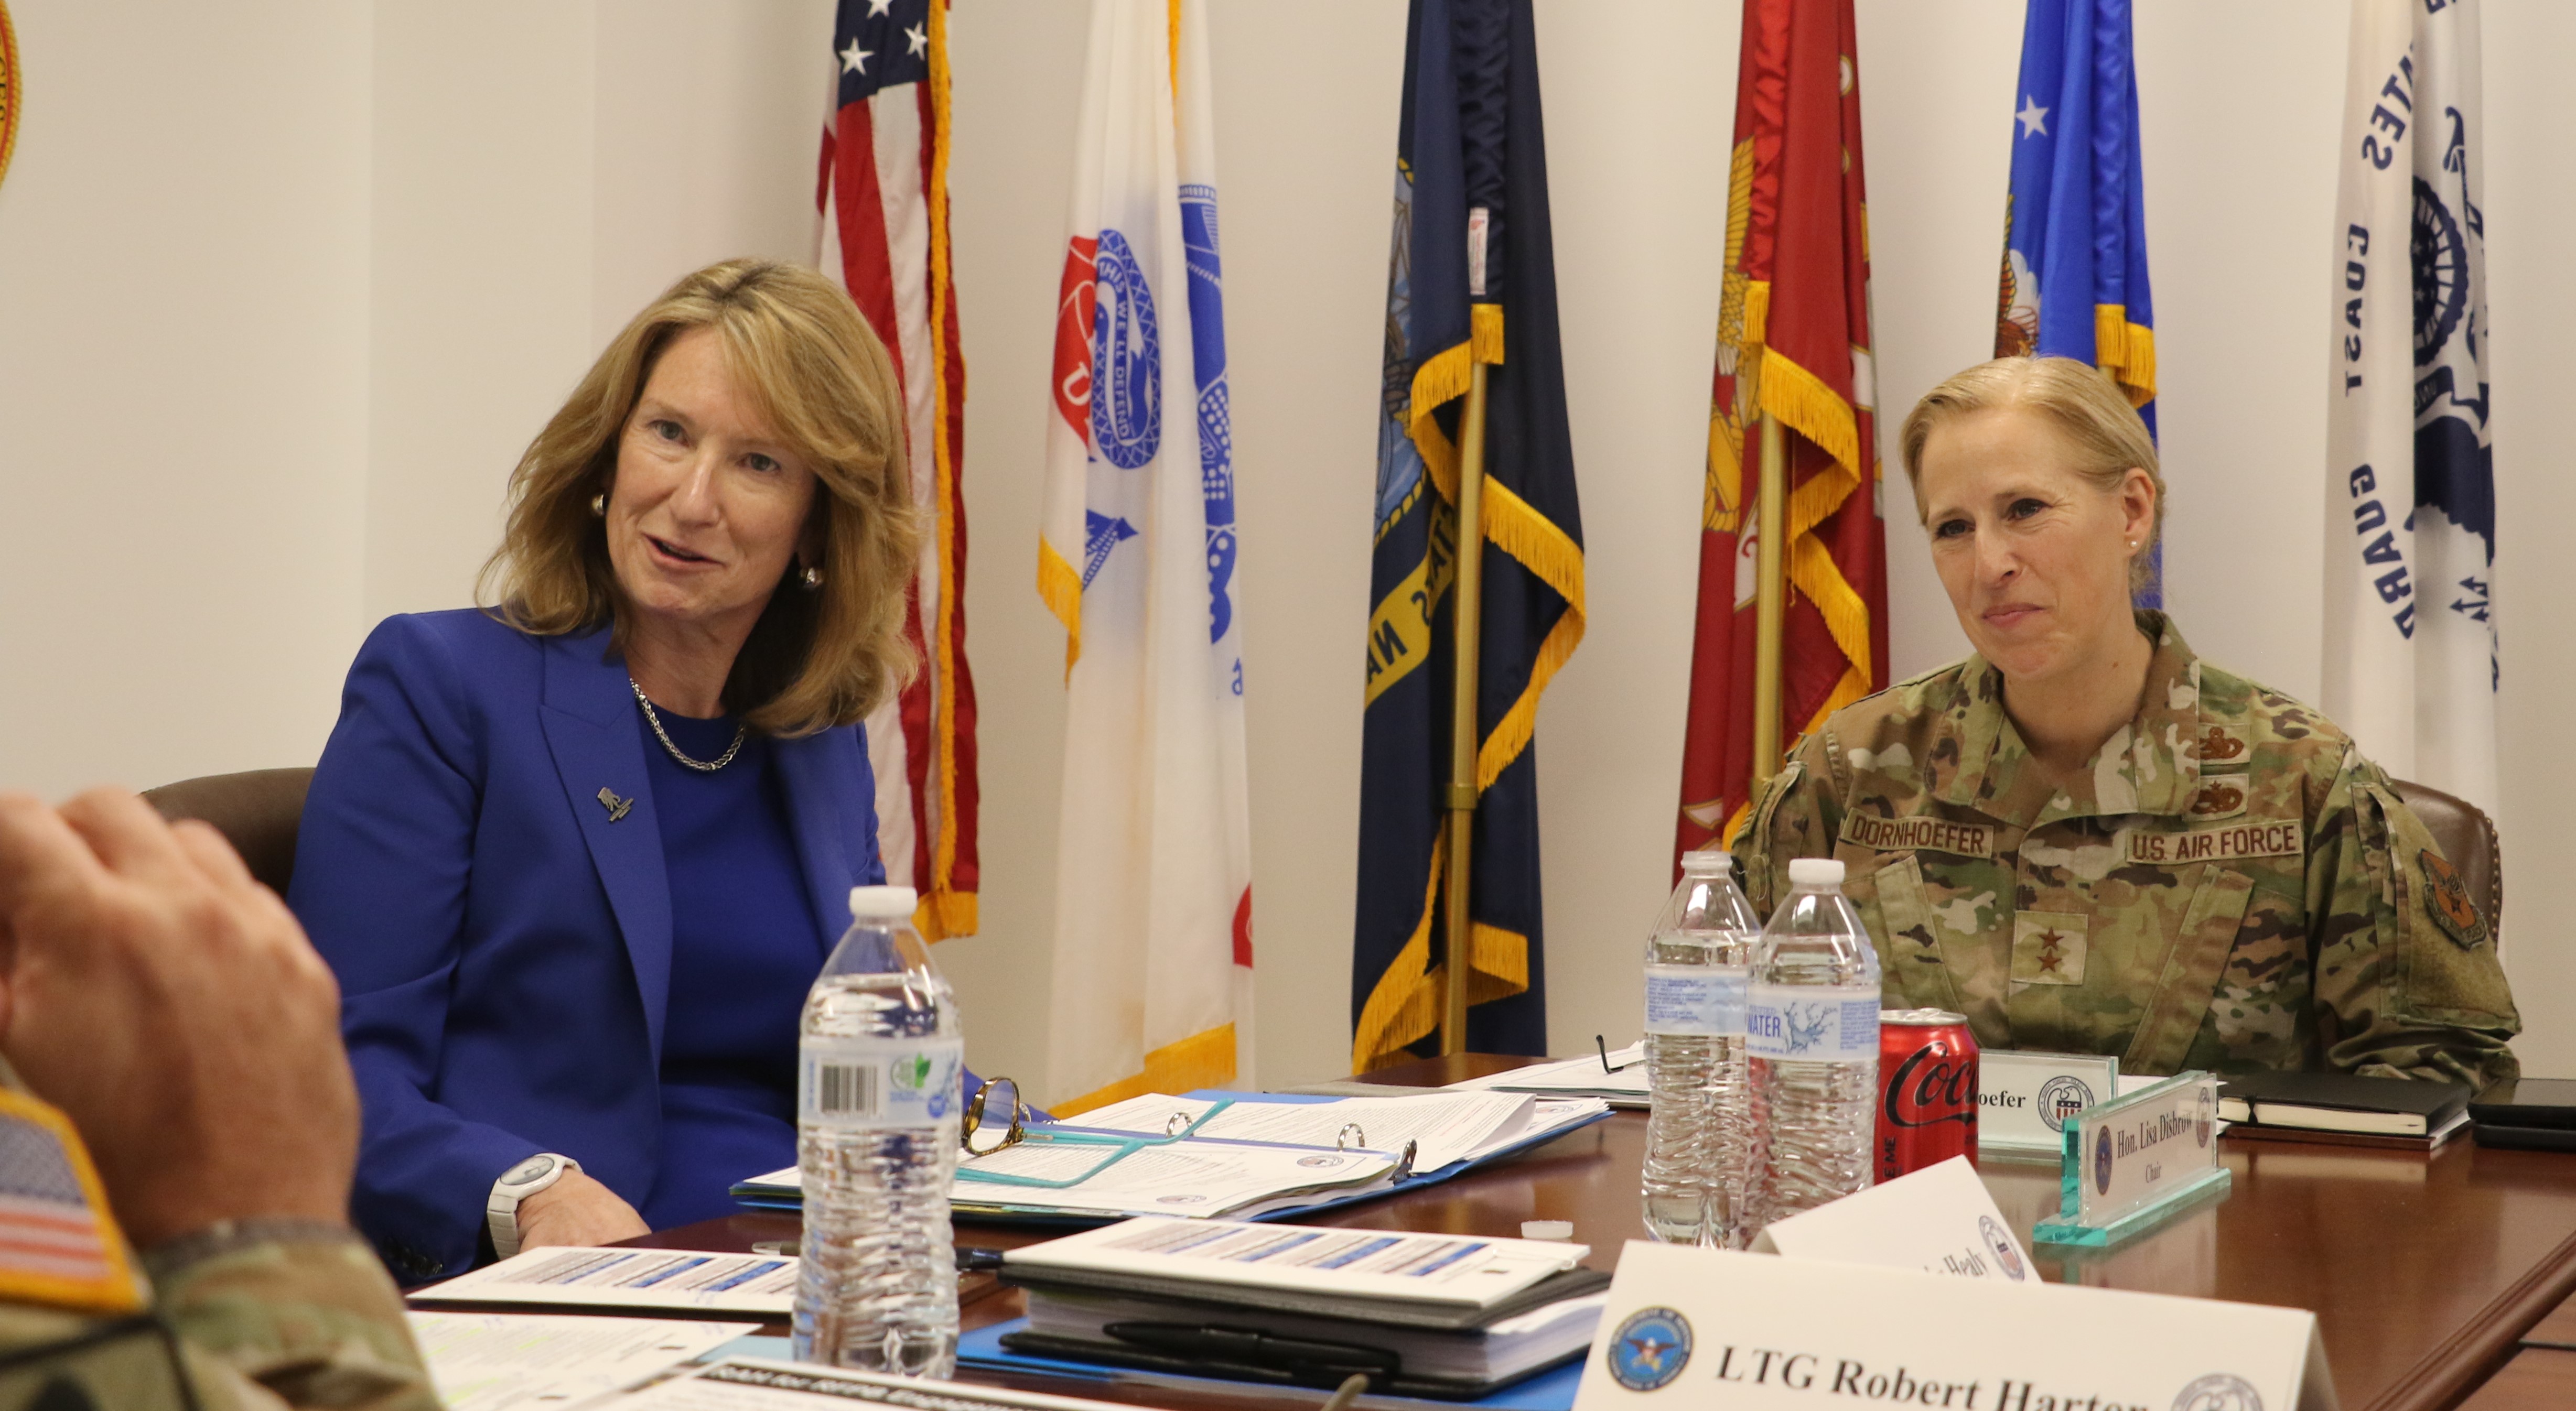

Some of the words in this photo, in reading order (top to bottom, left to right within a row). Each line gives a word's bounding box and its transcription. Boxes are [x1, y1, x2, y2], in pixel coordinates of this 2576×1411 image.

[1115, 368, 1130, 439] DEFEND
[1850, 815, 1985, 854] DORNHOEFER
[2132, 834, 2168, 861] U.S.
[2176, 835, 2213, 860] AIR
[2221, 825, 2296, 855] FORCE
[2118, 1130, 2138, 1159] Hon.
[2140, 1120, 2157, 1149] Lisa
[2160, 1111, 2193, 1142] Disbrow
[2146, 1162, 2161, 1184] Chair
[1712, 1345, 1819, 1390] LTG
[1831, 1359, 1981, 1410] Robert
